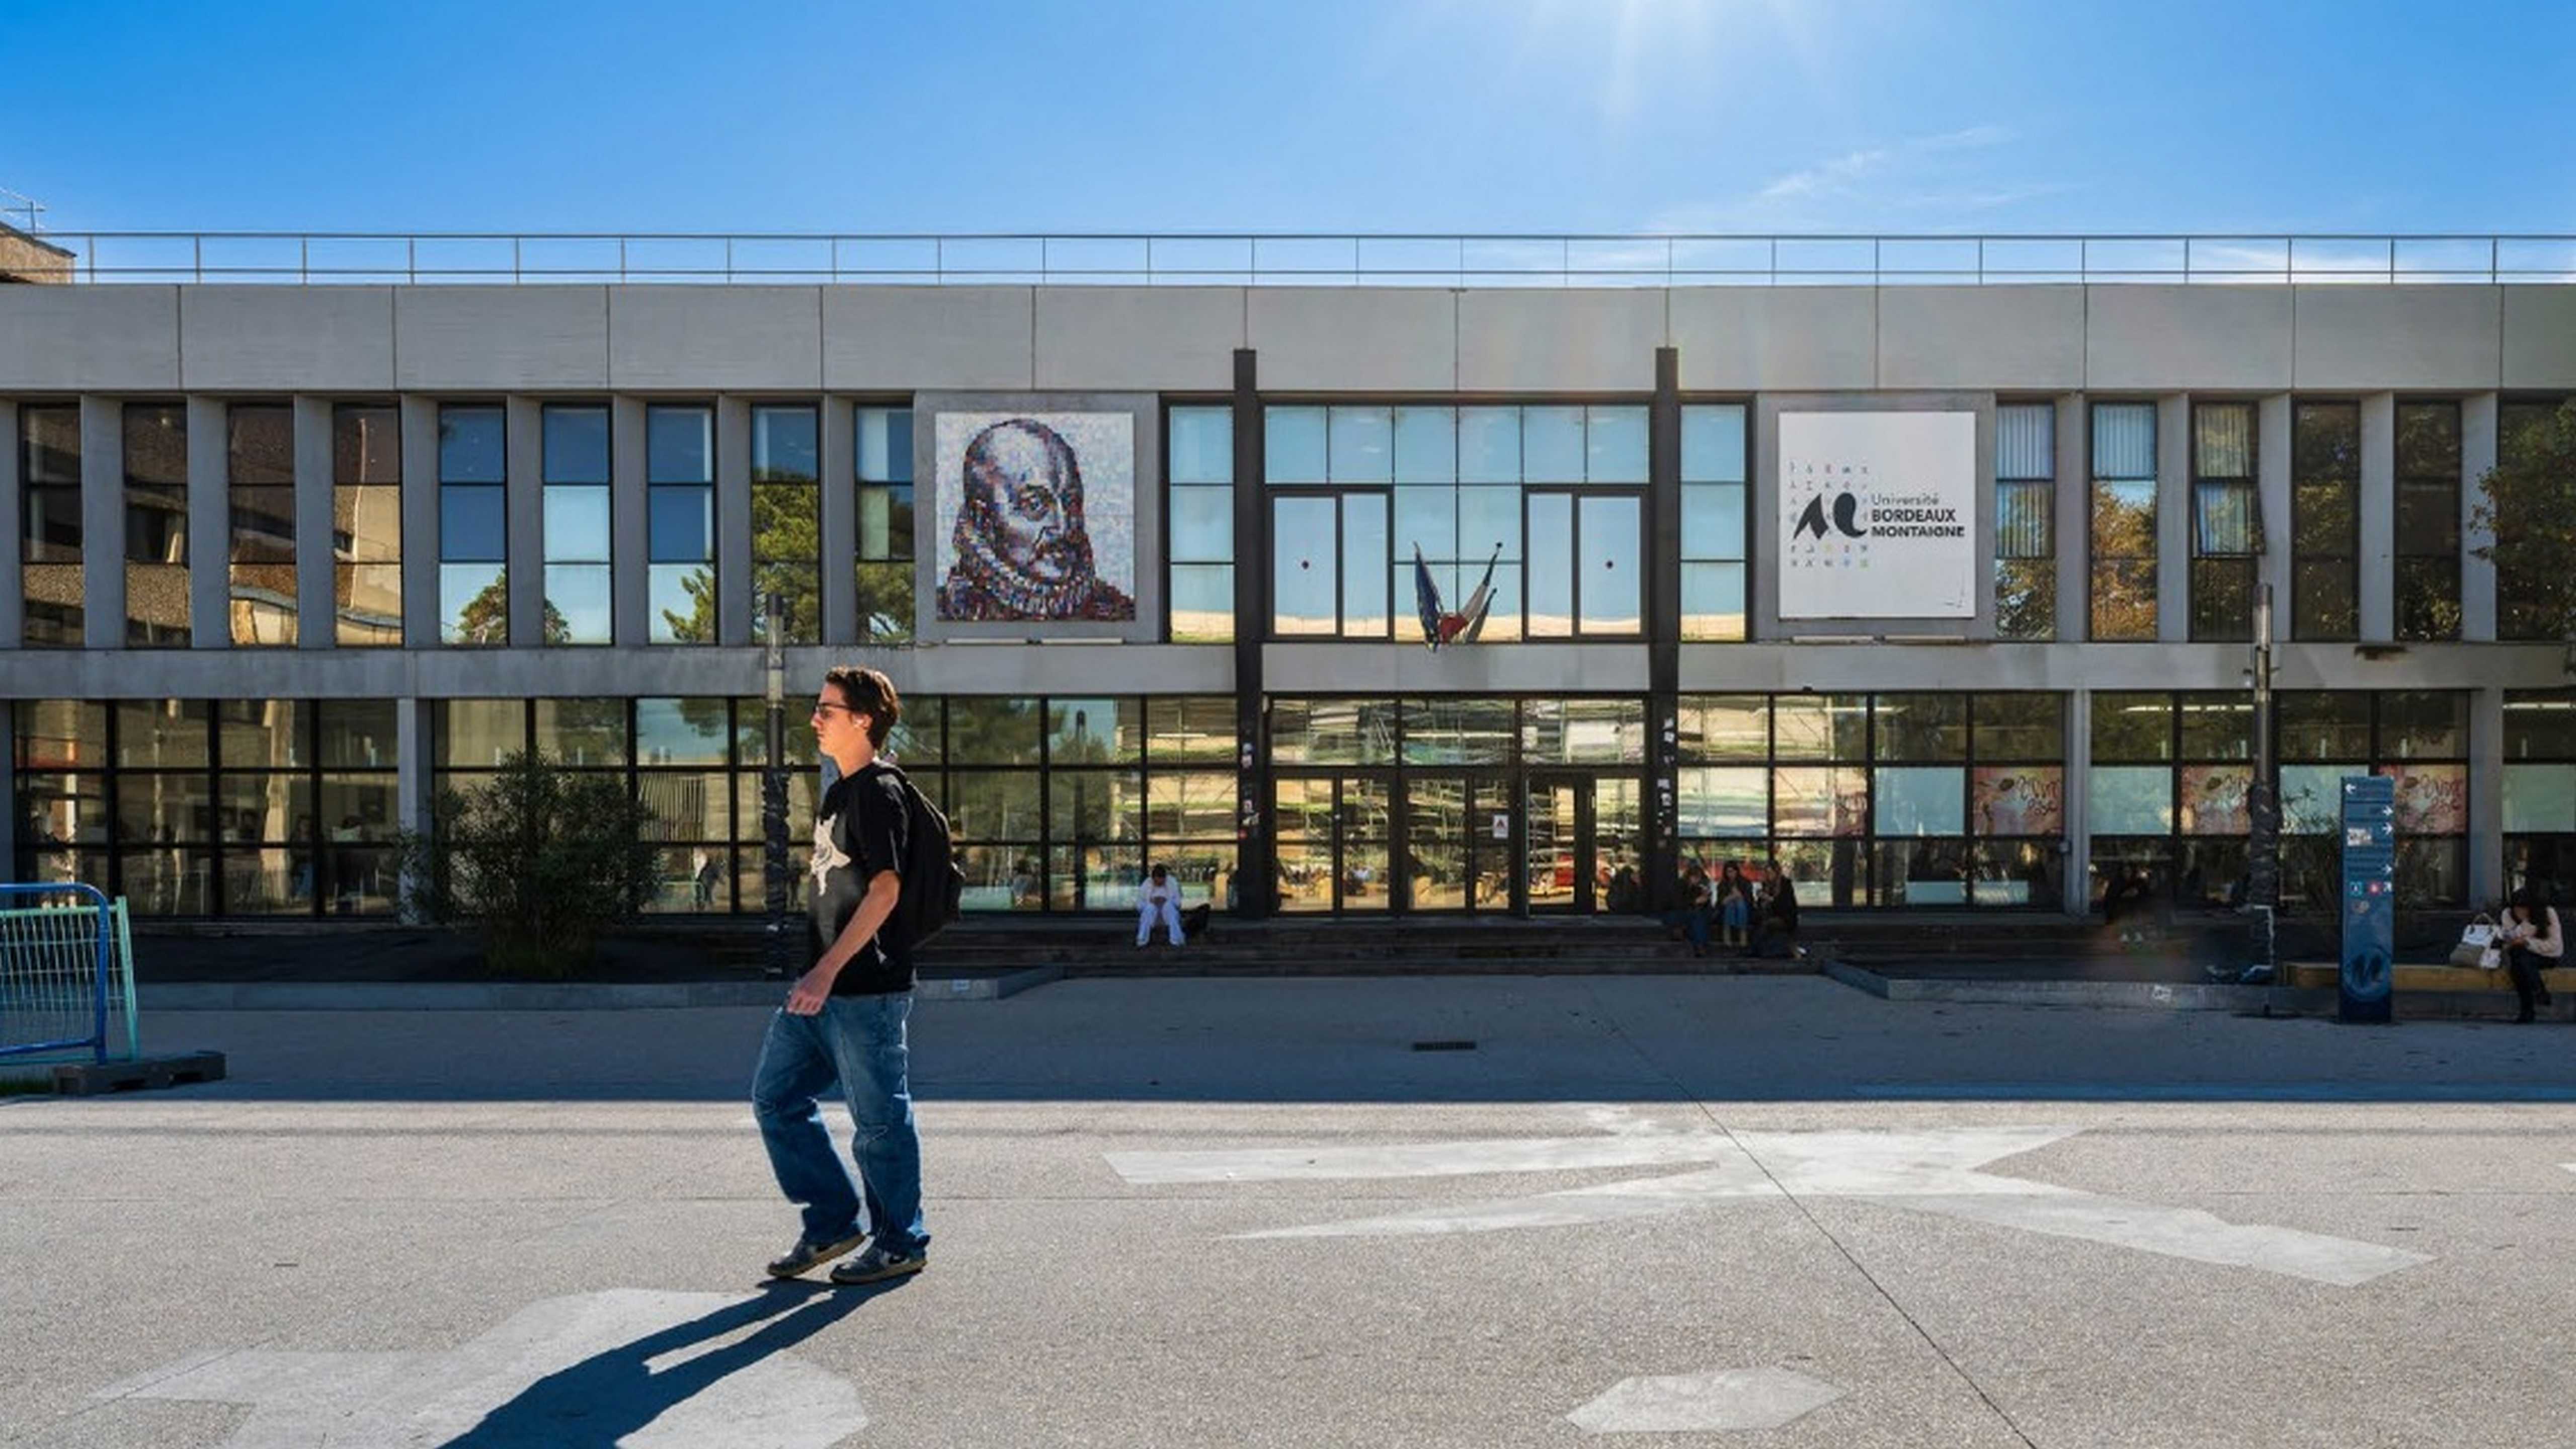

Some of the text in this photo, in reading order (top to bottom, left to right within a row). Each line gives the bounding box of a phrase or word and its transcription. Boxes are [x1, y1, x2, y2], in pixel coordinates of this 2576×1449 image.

[1872, 493, 1939, 505] Université
[1872, 509, 1956, 522] BORDEAUX
[1872, 526, 1964, 537] MONTAIGNE
